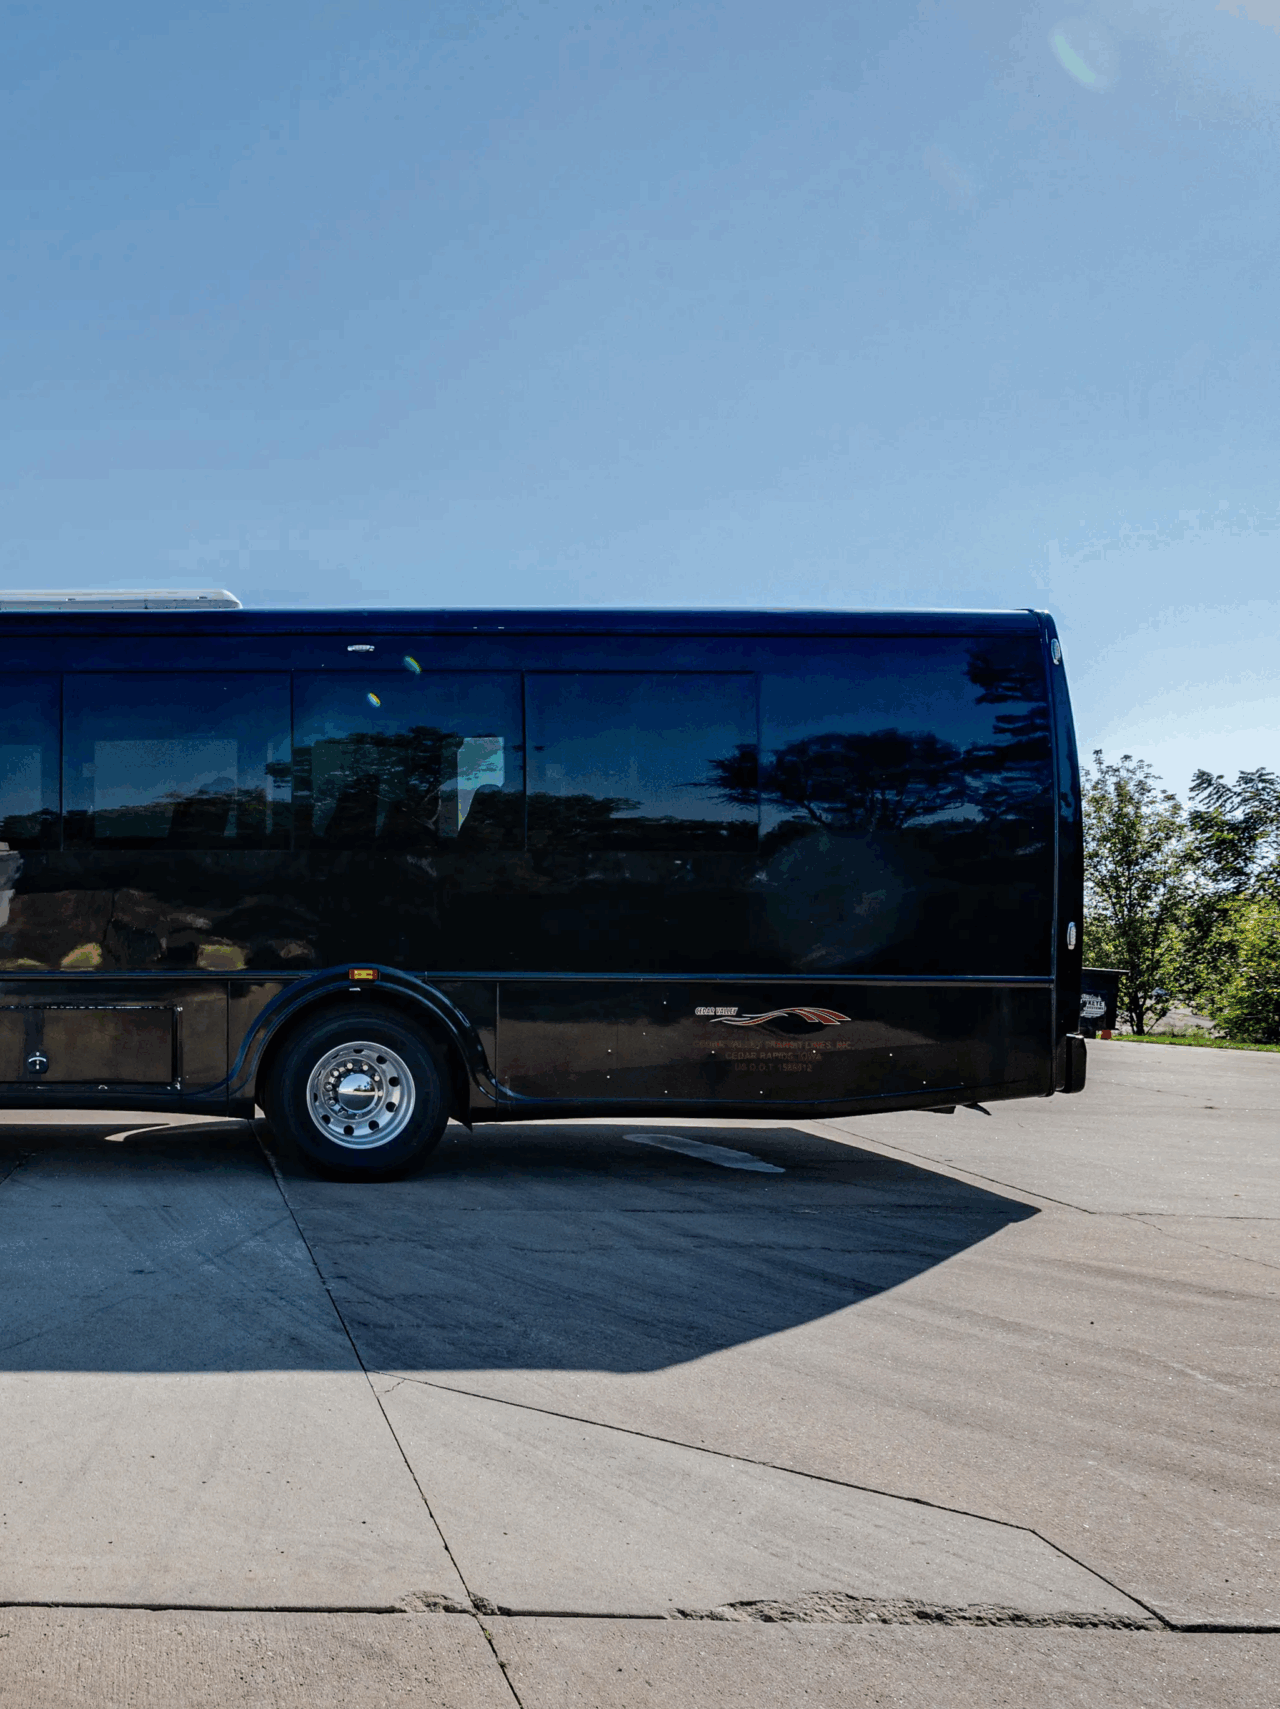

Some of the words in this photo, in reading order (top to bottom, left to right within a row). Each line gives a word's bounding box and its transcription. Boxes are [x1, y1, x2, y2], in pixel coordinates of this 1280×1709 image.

[694, 1007, 716, 1015] CEDAR
[716, 1007, 739, 1015] VALLEY
[725, 1052, 757, 1060] CEDAR
